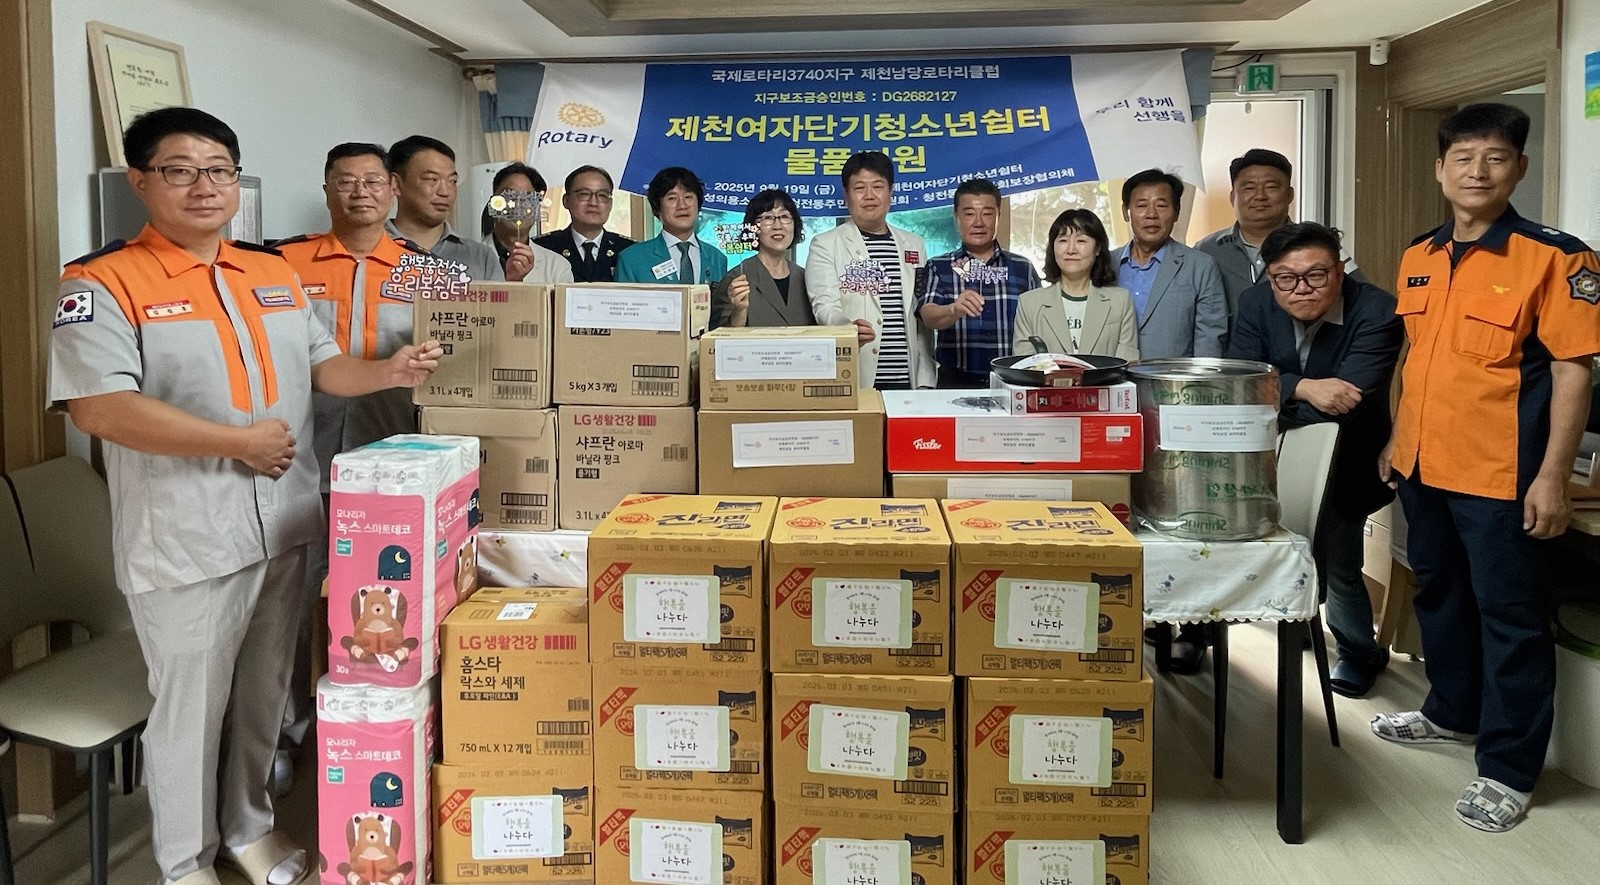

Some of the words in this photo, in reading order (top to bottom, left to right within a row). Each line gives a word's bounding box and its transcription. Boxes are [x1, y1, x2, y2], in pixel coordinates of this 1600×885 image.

[711, 68, 855, 82] 국제로타리3740지구
[861, 65, 1000, 81] 제천남당로타리클럽
[754, 90, 867, 104] 지구보조금승인번호
[882, 90, 957, 103] DG2682127
[1137, 96, 1174, 108] 함께
[665, 105, 1051, 142] 제천여자단기청소년쉼터
[538, 131, 614, 149] Rotary
[784, 145, 926, 176] 물품원
[714, 182, 755, 193] 2025년
[784, 185, 810, 194] 19일
[814, 185, 836, 195] (금)
[704, 193, 751, 206] 성의용소
[400, 253, 460, 275] 행복충전소
[55, 315, 88, 326] KOREA
[430, 311, 468, 327] 샤프란
[471, 316, 496, 328] 아로마
[430, 330, 454, 341] 바닐라
[457, 330, 473, 341] 핑크
[576, 436, 615, 451] 샤프란
[617, 440, 644, 451] 아로마
[912, 438, 942, 450] Fissler
[576, 454, 601, 465] 바닐라
[604, 454, 620, 465] 핑크
[336, 509, 366, 519] 모나리자
[656, 512, 750, 526] 진라면
[336, 519, 361, 535] 녹스
[363, 523, 412, 535] 스마트데코
[830, 517, 921, 530] 진라면
[1005, 518, 1100, 531] 진라면
[659, 598, 686, 611] 행복을
[849, 603, 877, 615] 행복을
[1033, 604, 1062, 618] 행복을
[657, 612, 688, 623] 나누다
[847, 616, 879, 627] 나누다
[1031, 618, 1064, 630] 나누다
[460, 656, 501, 674] 홈스타
[460, 676, 496, 690] 락스와
[501, 676, 525, 690] 세제
[669, 727, 696, 740] 행복을
[845, 731, 873, 745] 행복을
[326, 737, 356, 747] 모나리자
[460, 743, 477, 752] 750
[479, 743, 491, 752] mL
[503, 743, 513, 752] 12
[515, 743, 532, 754] 개입
[667, 741, 698, 751] 나누다
[1048, 738, 1076, 753] 행복을
[326, 748, 352, 763] 녹스
[355, 750, 402, 763] 스마트데코
[843, 746, 875, 757] 나누다
[1045, 754, 1078, 765] 나누다
[505, 817, 531, 829] 행복을
[503, 830, 533, 840] 나누다
[664, 842, 690, 855] 행복을
[662, 856, 692, 866] 나누다
[848, 861, 877, 874] 행복을
[1042, 863, 1070, 877] 행복을
[847, 875, 878, 885] 나누다
